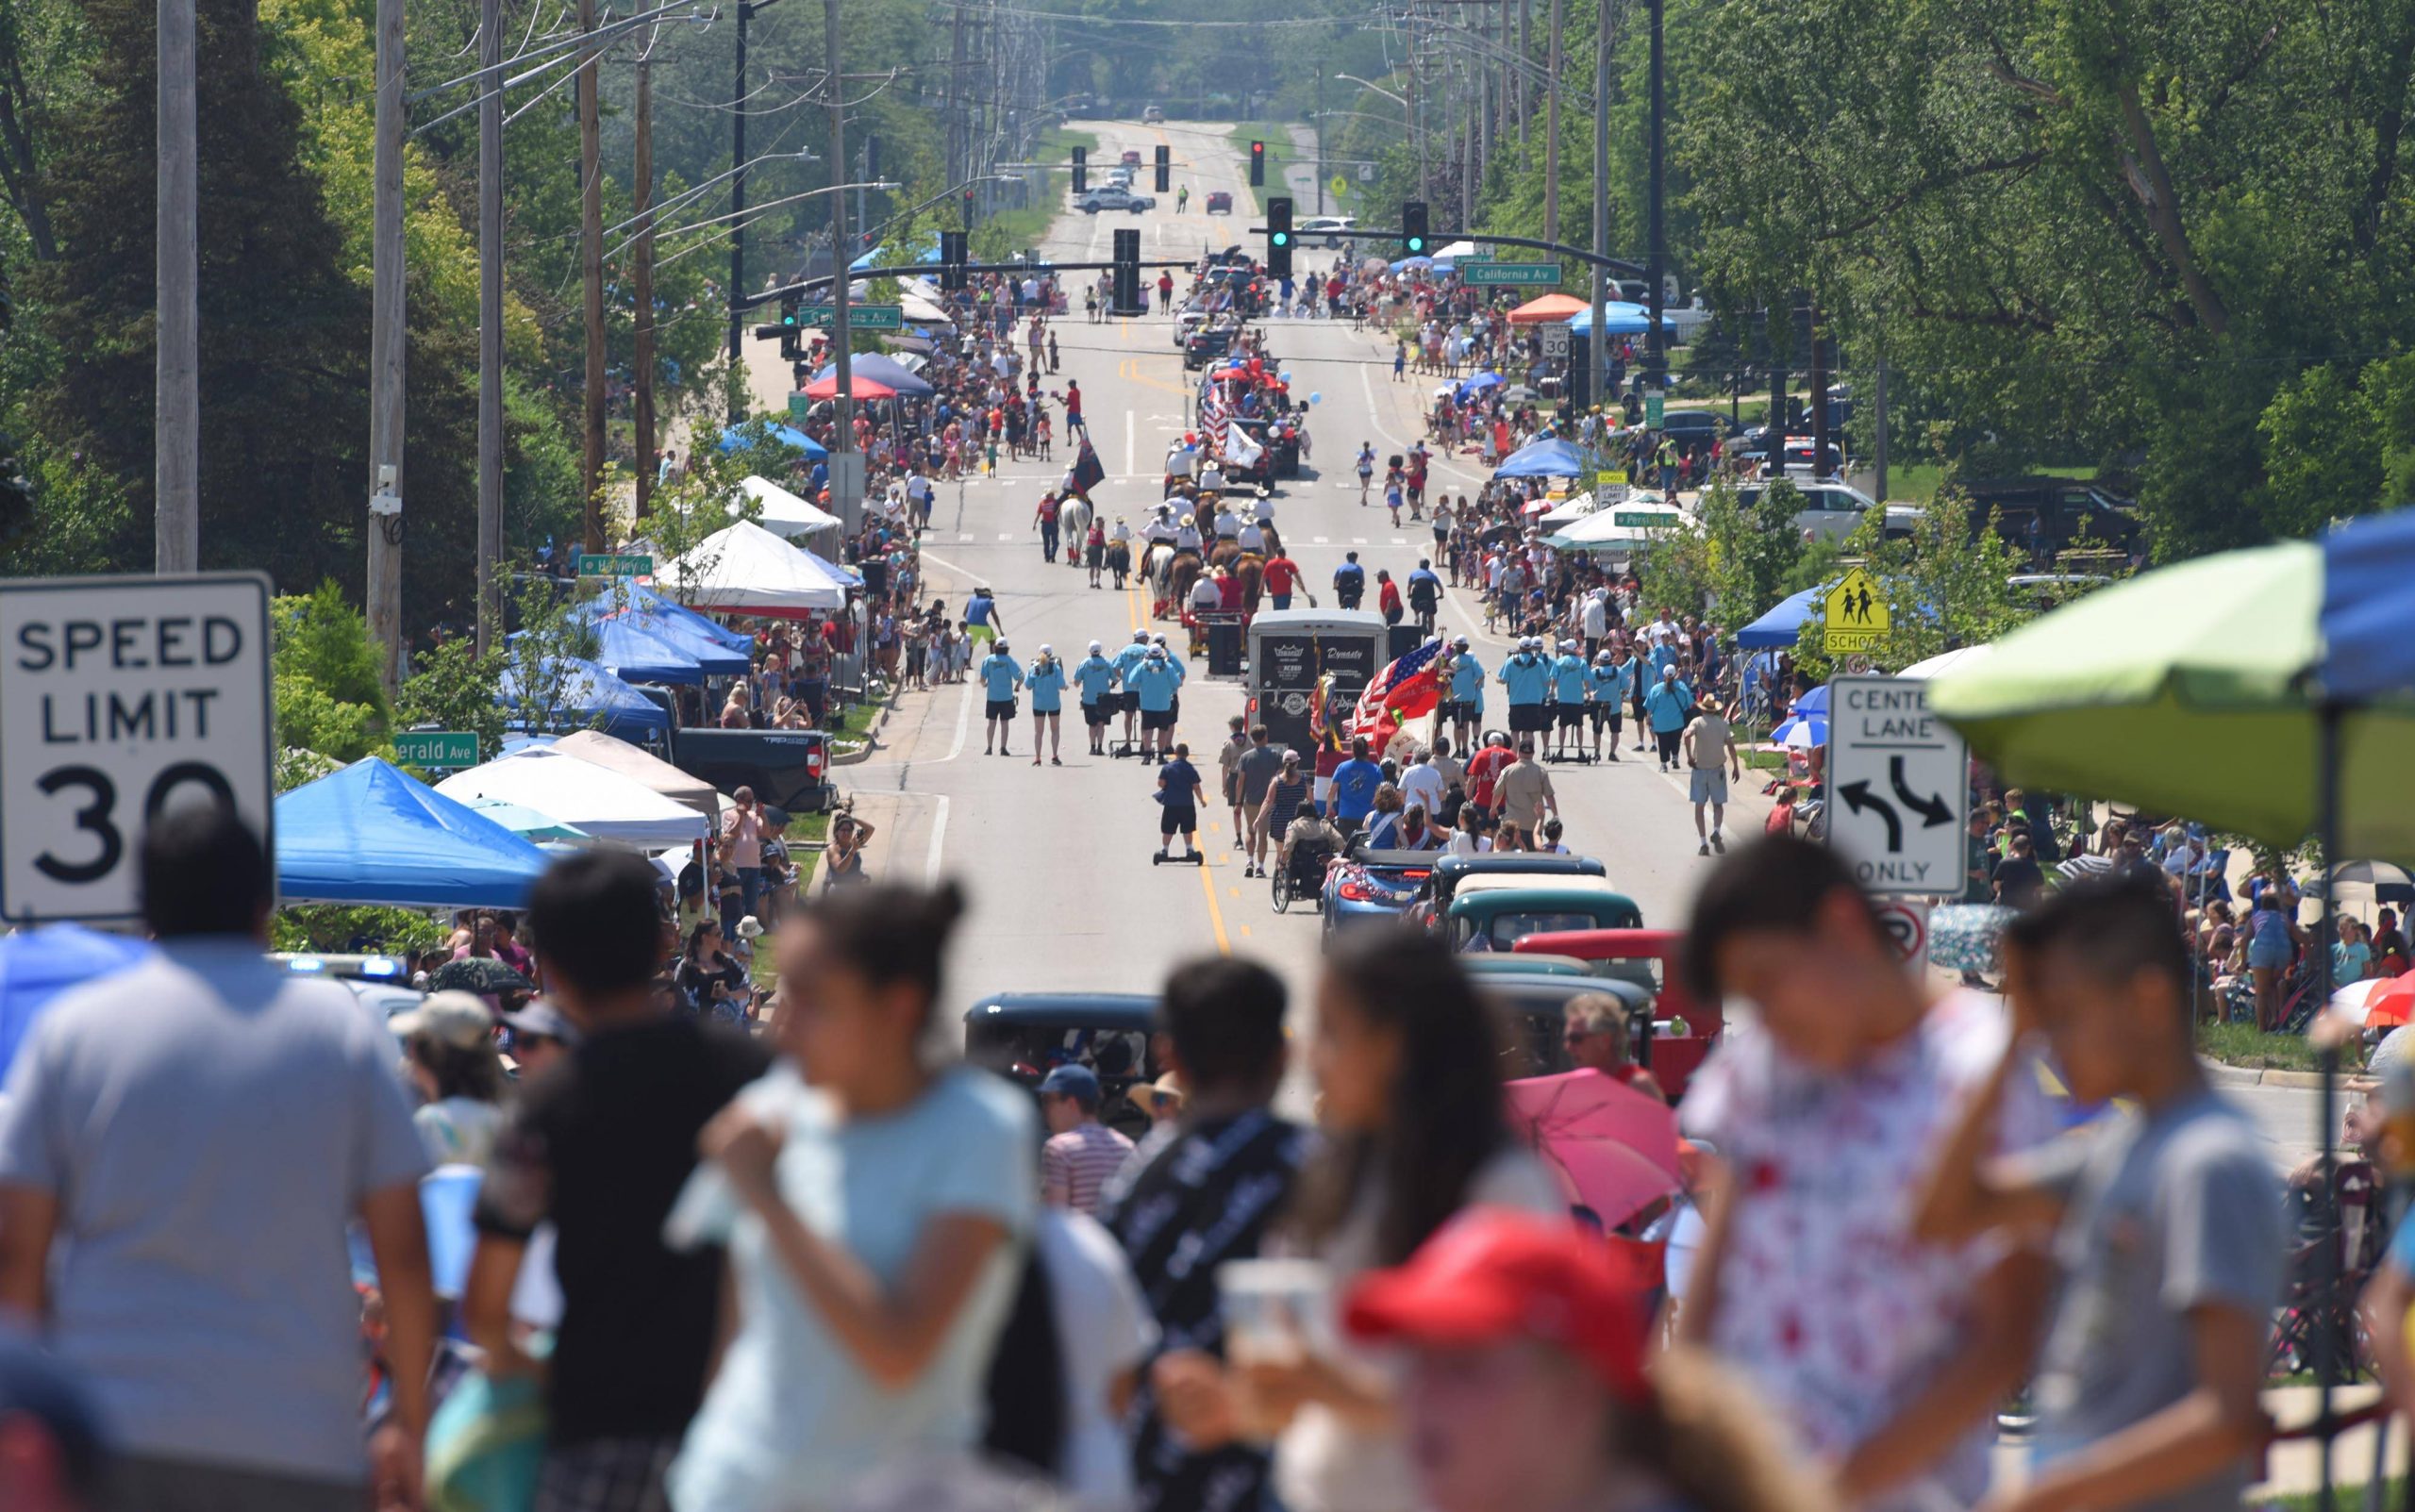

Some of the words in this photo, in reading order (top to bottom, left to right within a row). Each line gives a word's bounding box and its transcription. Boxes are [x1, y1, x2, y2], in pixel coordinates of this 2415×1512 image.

[1476, 269, 1528, 280] California
[1533, 269, 1549, 280] Av
[871, 311, 888, 323] Av
[1546, 341, 1567, 354] 30
[1601, 501, 1622, 510] 2
[17, 616, 242, 672] SPEED
[1829, 635, 1876, 648] SCHOO
[1326, 647, 1363, 659] Dynasty
[1847, 689, 1928, 709] CENTE
[41, 688, 220, 744] LIMIT
[1863, 718, 1934, 739] LANE
[397, 739, 444, 759] erald
[449, 747, 471, 759] Ave
[1857, 860, 1931, 882] ONLY
